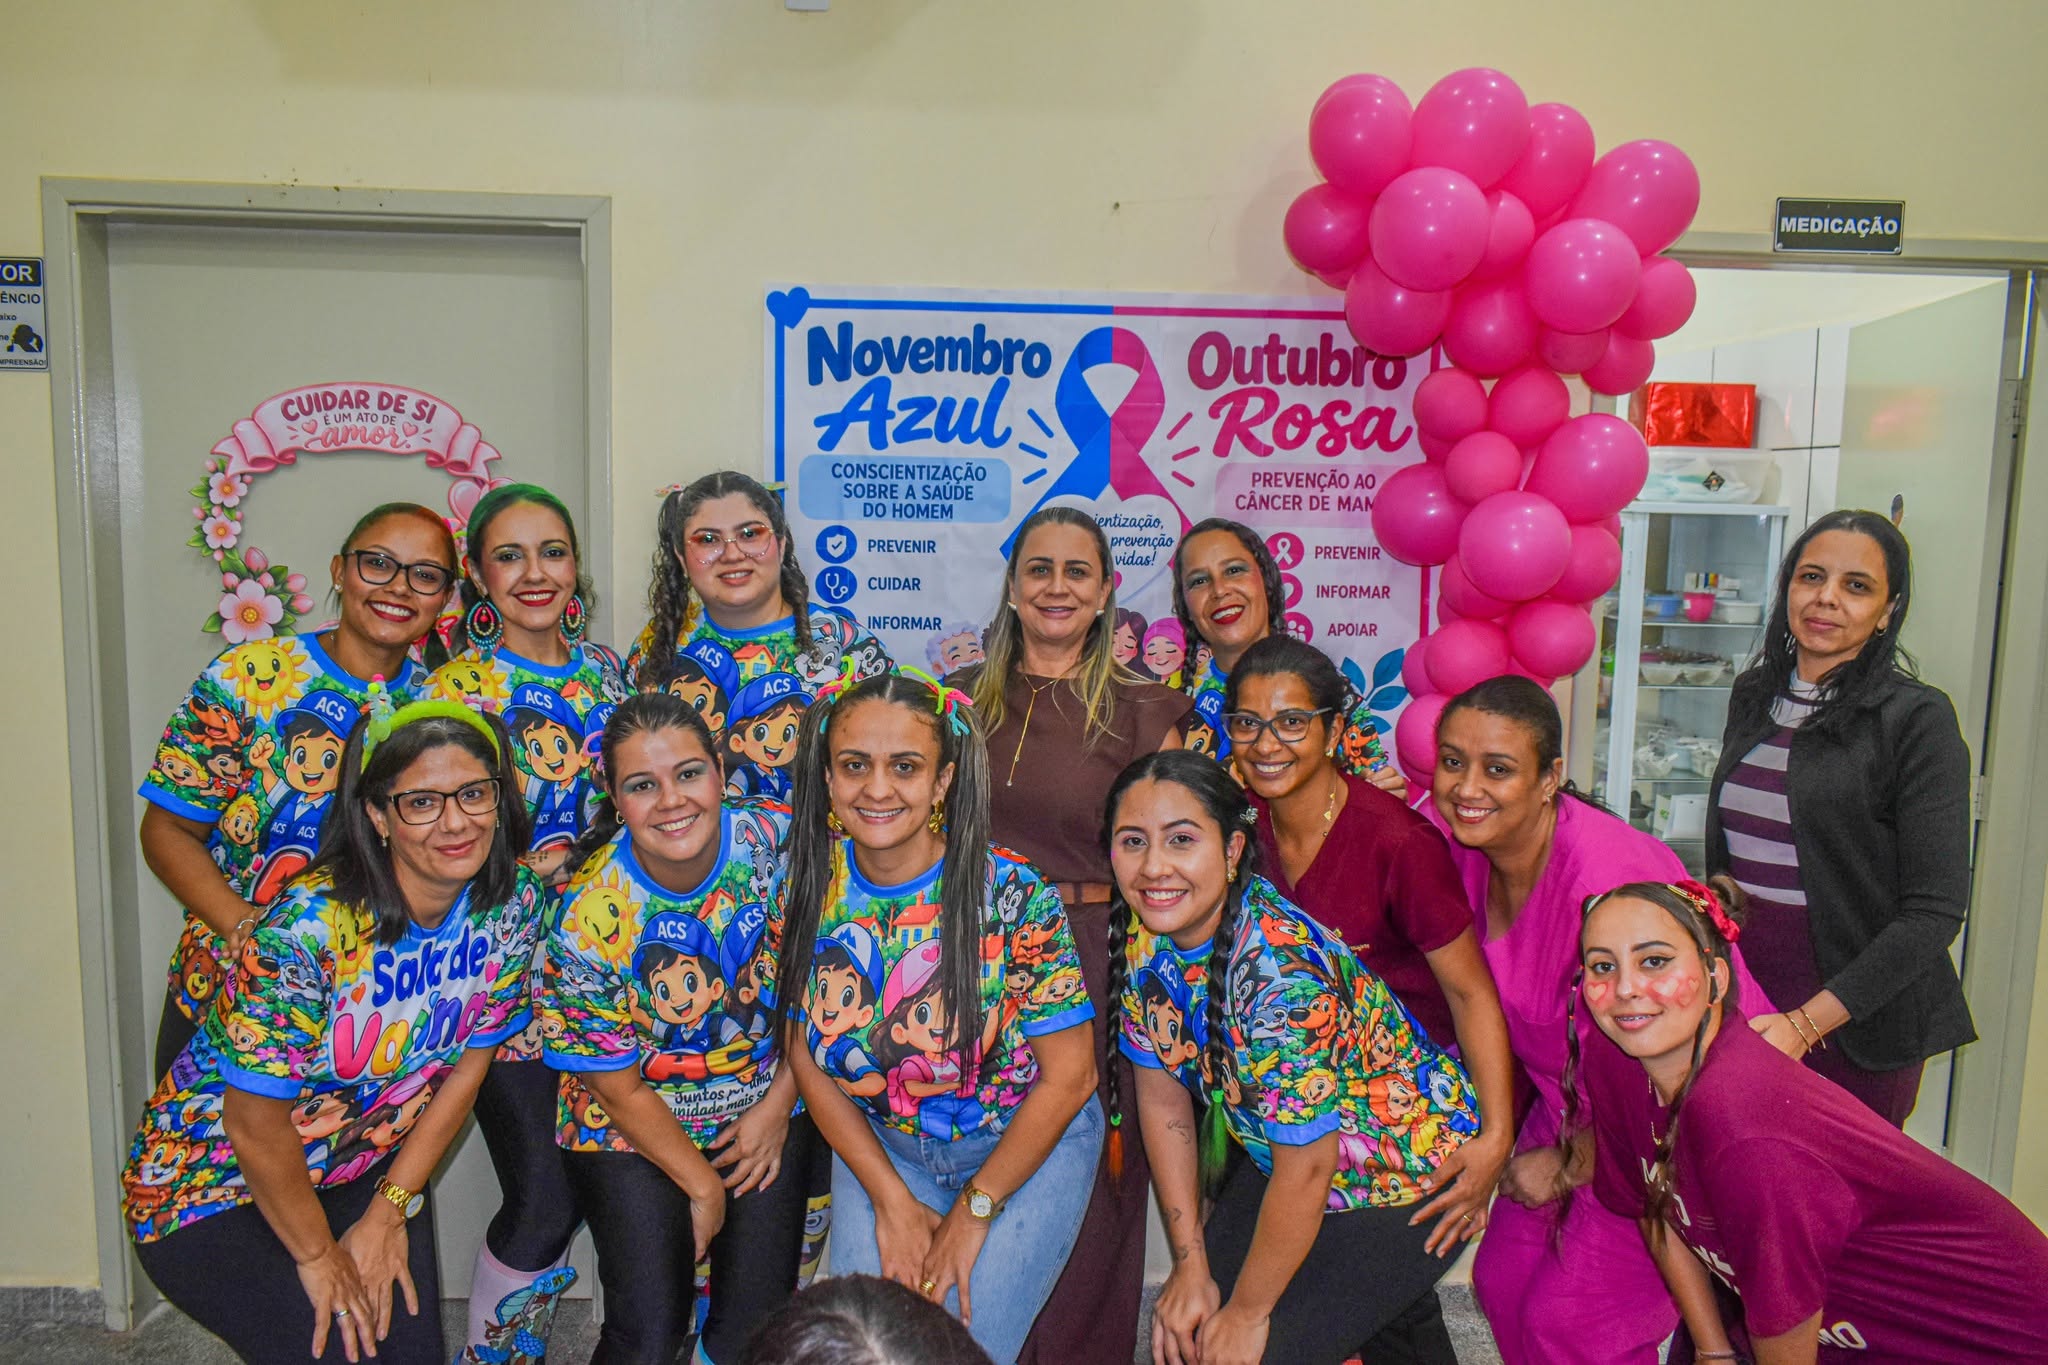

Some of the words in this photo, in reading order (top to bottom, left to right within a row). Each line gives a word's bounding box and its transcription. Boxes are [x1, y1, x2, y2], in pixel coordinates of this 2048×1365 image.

[1780, 216, 1898, 238] MEDICAÇÃO
[0, 264, 34, 281] OR
[807, 321, 1052, 386] Novembro
[1187, 331, 1408, 391] Outubro
[281, 389, 370, 421] CUIDAR
[377, 391, 408, 414] DE
[411, 399, 437, 424] SI
[813, 375, 1012, 451] Azul
[323, 413, 331, 425] É
[334, 413, 352, 424] UM
[356, 413, 379, 423] ATO
[382, 415, 397, 425] DE
[1208, 386, 1413, 457] Rosa
[831, 462, 987, 484] CONSCIENTIZAÇÃO
[1251, 469, 1350, 492] PREVENÇÃO
[1354, 473, 1376, 490] AO
[843, 483, 899, 500] SOBRE
[904, 484, 917, 500] A
[922, 480, 974, 501] SAÚDE
[1235, 490, 1302, 511] CÂNCER
[1309, 495, 1330, 511] DE
[863, 502, 887, 518] DO
[892, 503, 953, 519] HOMEM
[868, 539, 936, 553] PREVENIR
[1110, 533, 1174, 550] prevenção
[1115, 550, 1157, 566] vidas!
[1314, 546, 1381, 560] PREVENIR
[868, 577, 921, 591] CUIDAR
[1316, 585, 1391, 599] INFORMAR
[868, 616, 942, 631] INFORMAR
[1327, 623, 1378, 637] APOIAR
[695, 644, 723, 669] ACS
[763, 677, 791, 698] ACS
[525, 689, 553, 709] ACS
[1200, 695, 1220, 714] ACS
[314, 696, 347, 722] ACS
[558, 811, 574, 824] ACS
[270, 821, 287, 834] ACS
[297, 825, 317, 839] ACS
[657, 920, 687, 939] ACS
[737, 908, 765, 938] ACS
[448, 925, 488, 980] de
[671, 1101, 722, 1116] unidade
[727, 1094, 754, 1110] mais
[675, 1088, 724, 1104] Juntos
